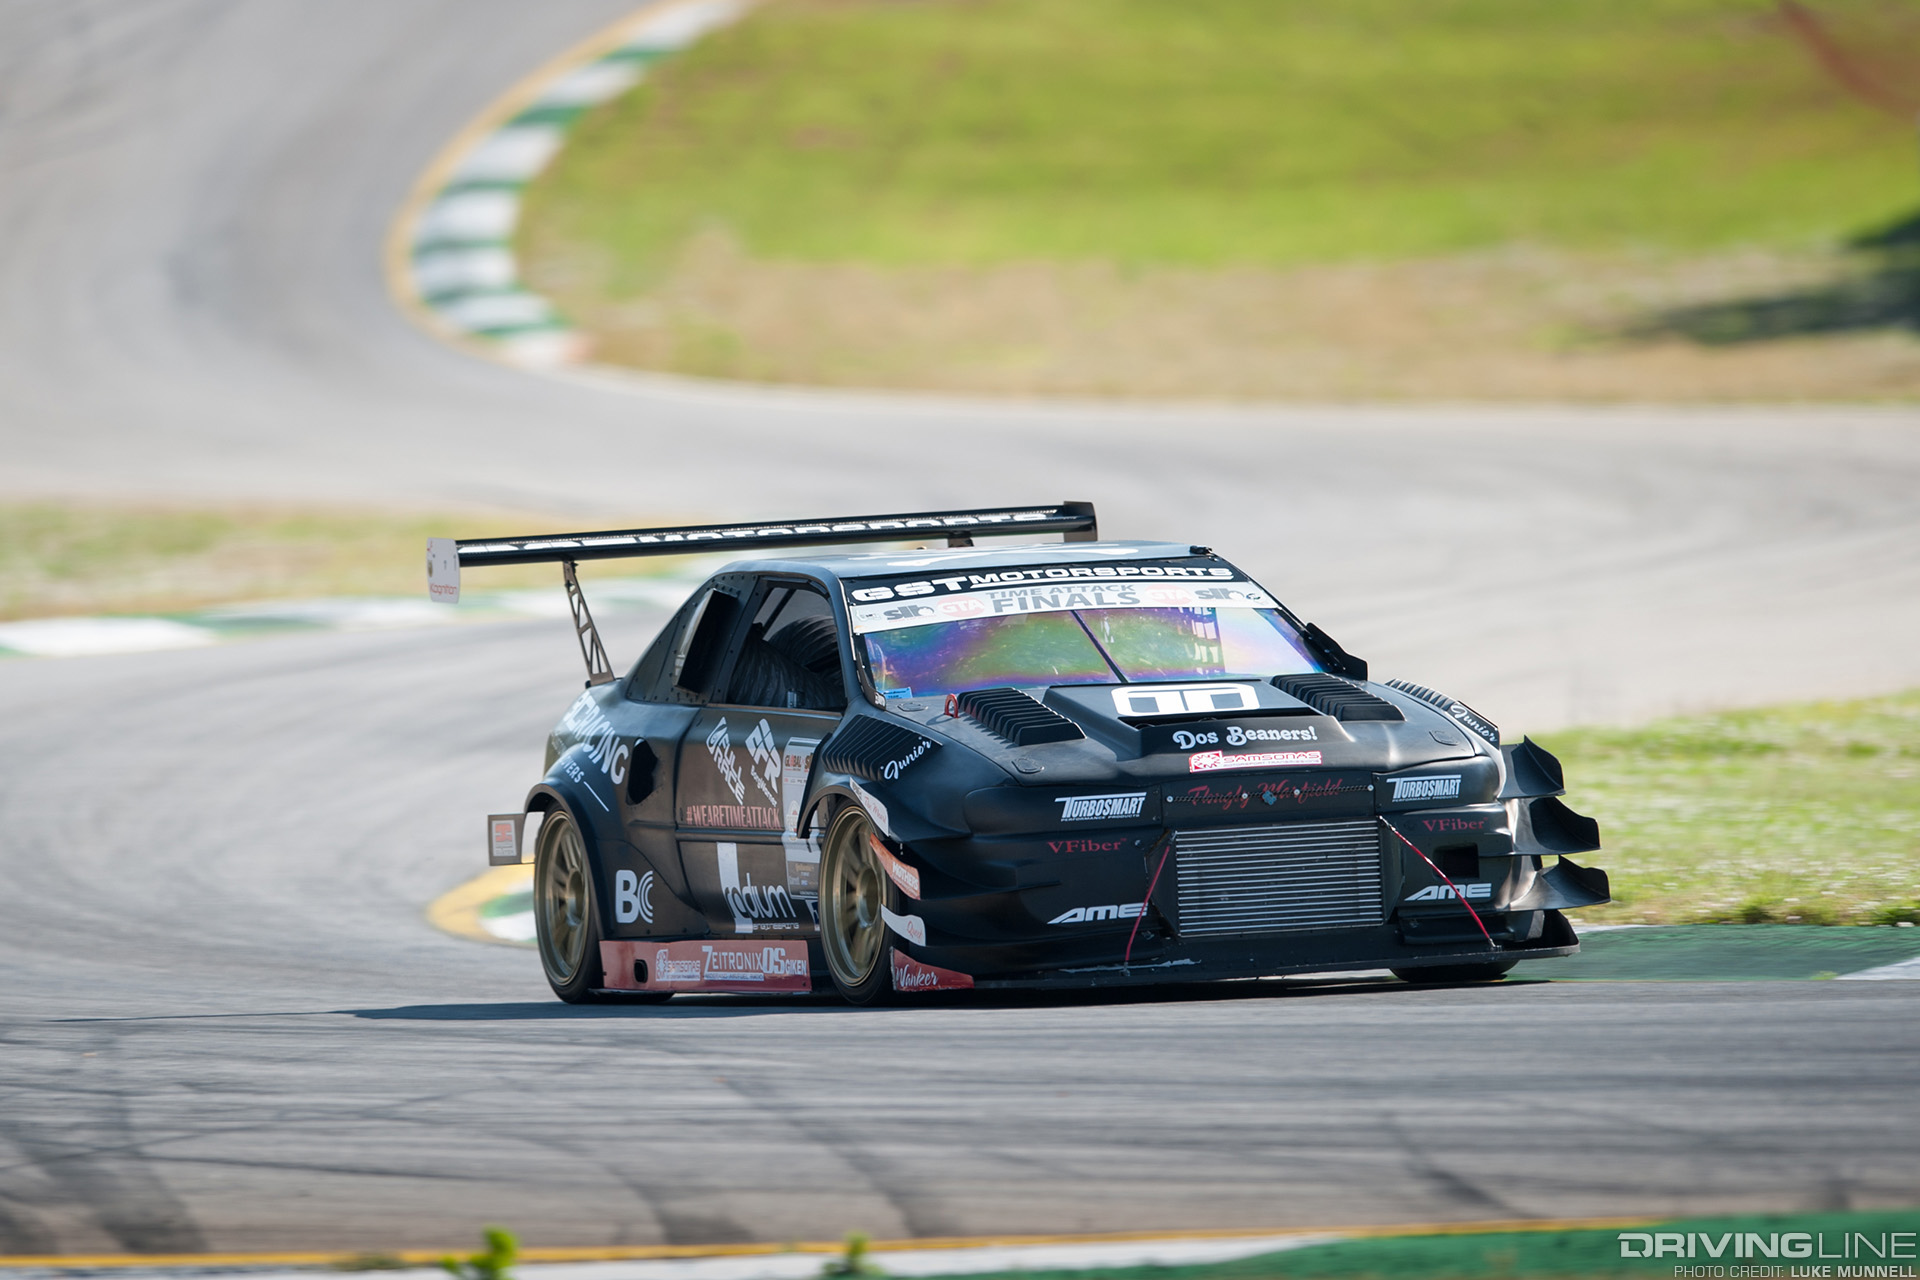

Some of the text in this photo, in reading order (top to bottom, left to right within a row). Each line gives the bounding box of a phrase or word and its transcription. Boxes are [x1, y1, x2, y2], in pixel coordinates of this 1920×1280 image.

[986, 584, 1135, 599] TIME ATTACK
[993, 591, 1141, 613] FINALS
[1450, 704, 1497, 742] Junior
[1172, 726, 1318, 749] Dos Beaners!
[1223, 752, 1320, 763] SAMSONAS
[1386, 775, 1462, 799] TURBOSMART
[687, 804, 782, 830] #WEARETIMEATTACK
[1054, 792, 1147, 819] TURBOSMART
[1403, 883, 1493, 901] AME
[1046, 902, 1149, 924] AME
[702, 945, 765, 974] ZEITRONIX
[785, 959, 807, 976] GIKEN
[894, 963, 939, 987] Wanker
